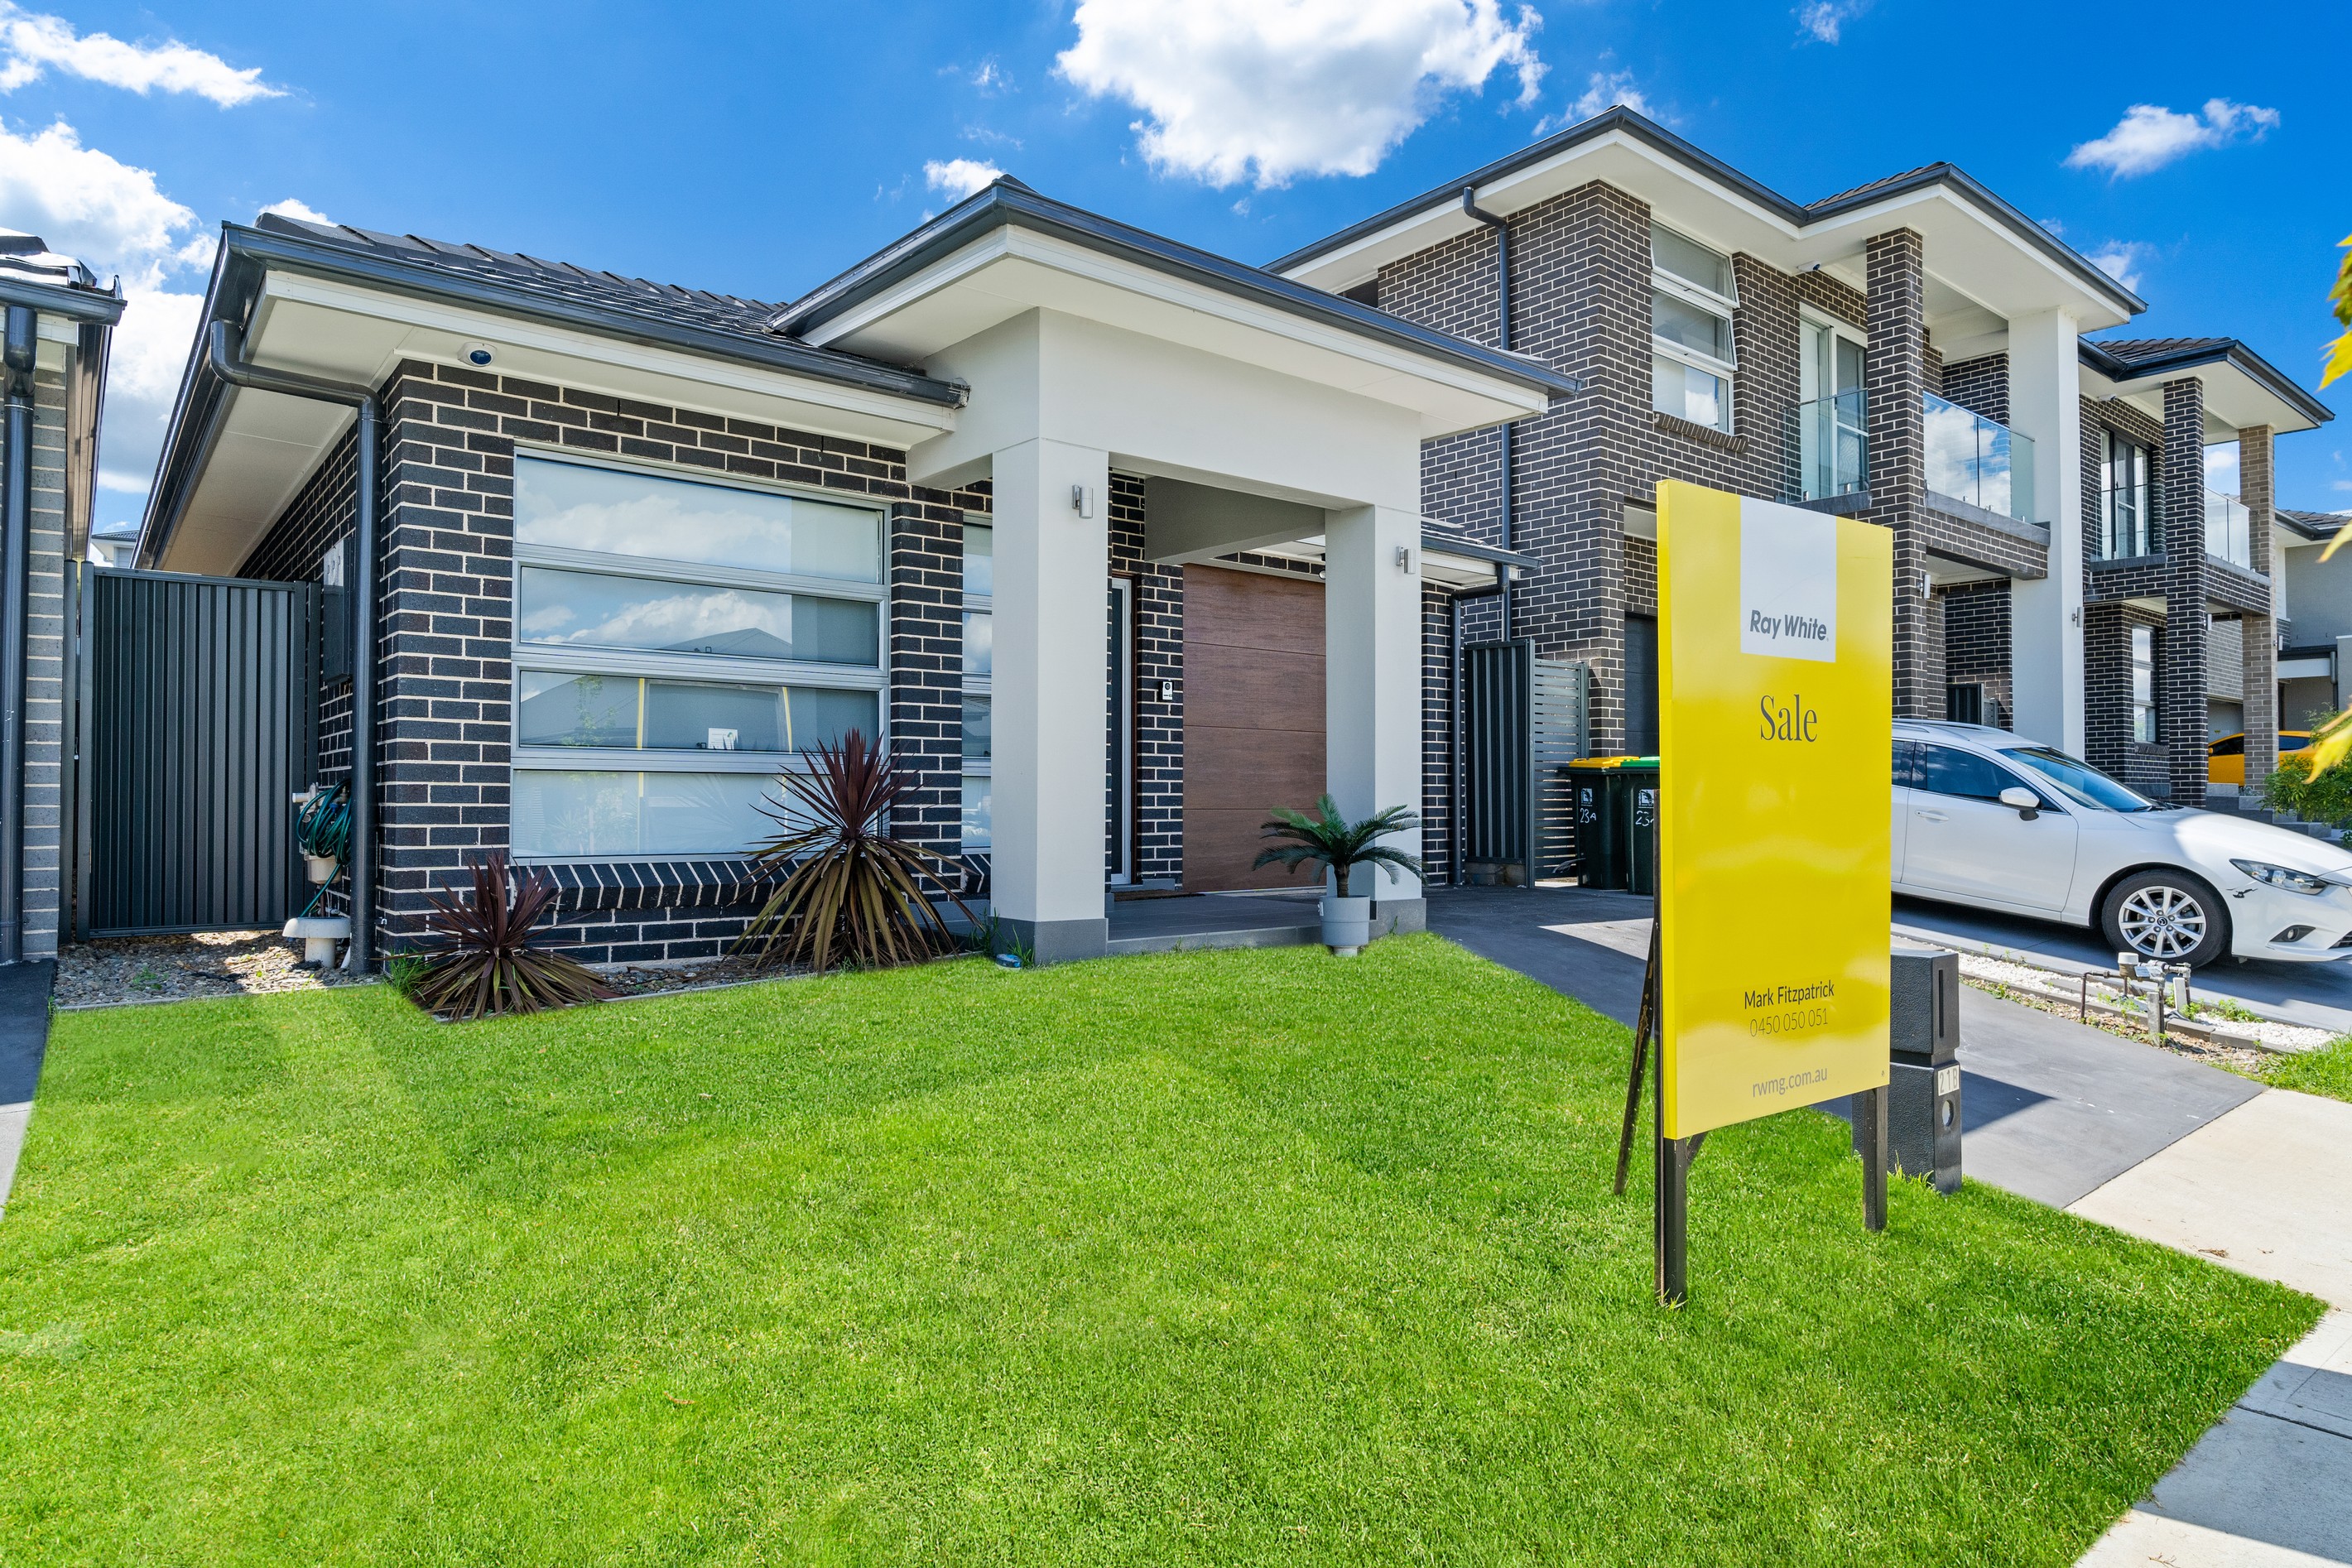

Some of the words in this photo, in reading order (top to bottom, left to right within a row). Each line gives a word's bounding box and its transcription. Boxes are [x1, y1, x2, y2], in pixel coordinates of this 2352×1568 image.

[1749, 609, 1782, 640] Ray
[1784, 614, 1827, 641] White
[1760, 694, 1818, 743] Sale
[1744, 987, 1774, 1009] Mark
[1777, 979, 1835, 1005] Fitzpatrick
[1749, 1015, 1781, 1037] 0450
[1783, 1011, 1806, 1032] 050
[1808, 1008, 1828, 1027] 051
[1753, 1067, 1828, 1098] rwmg.com.au
[1939, 1067, 1958, 1094] 21B
